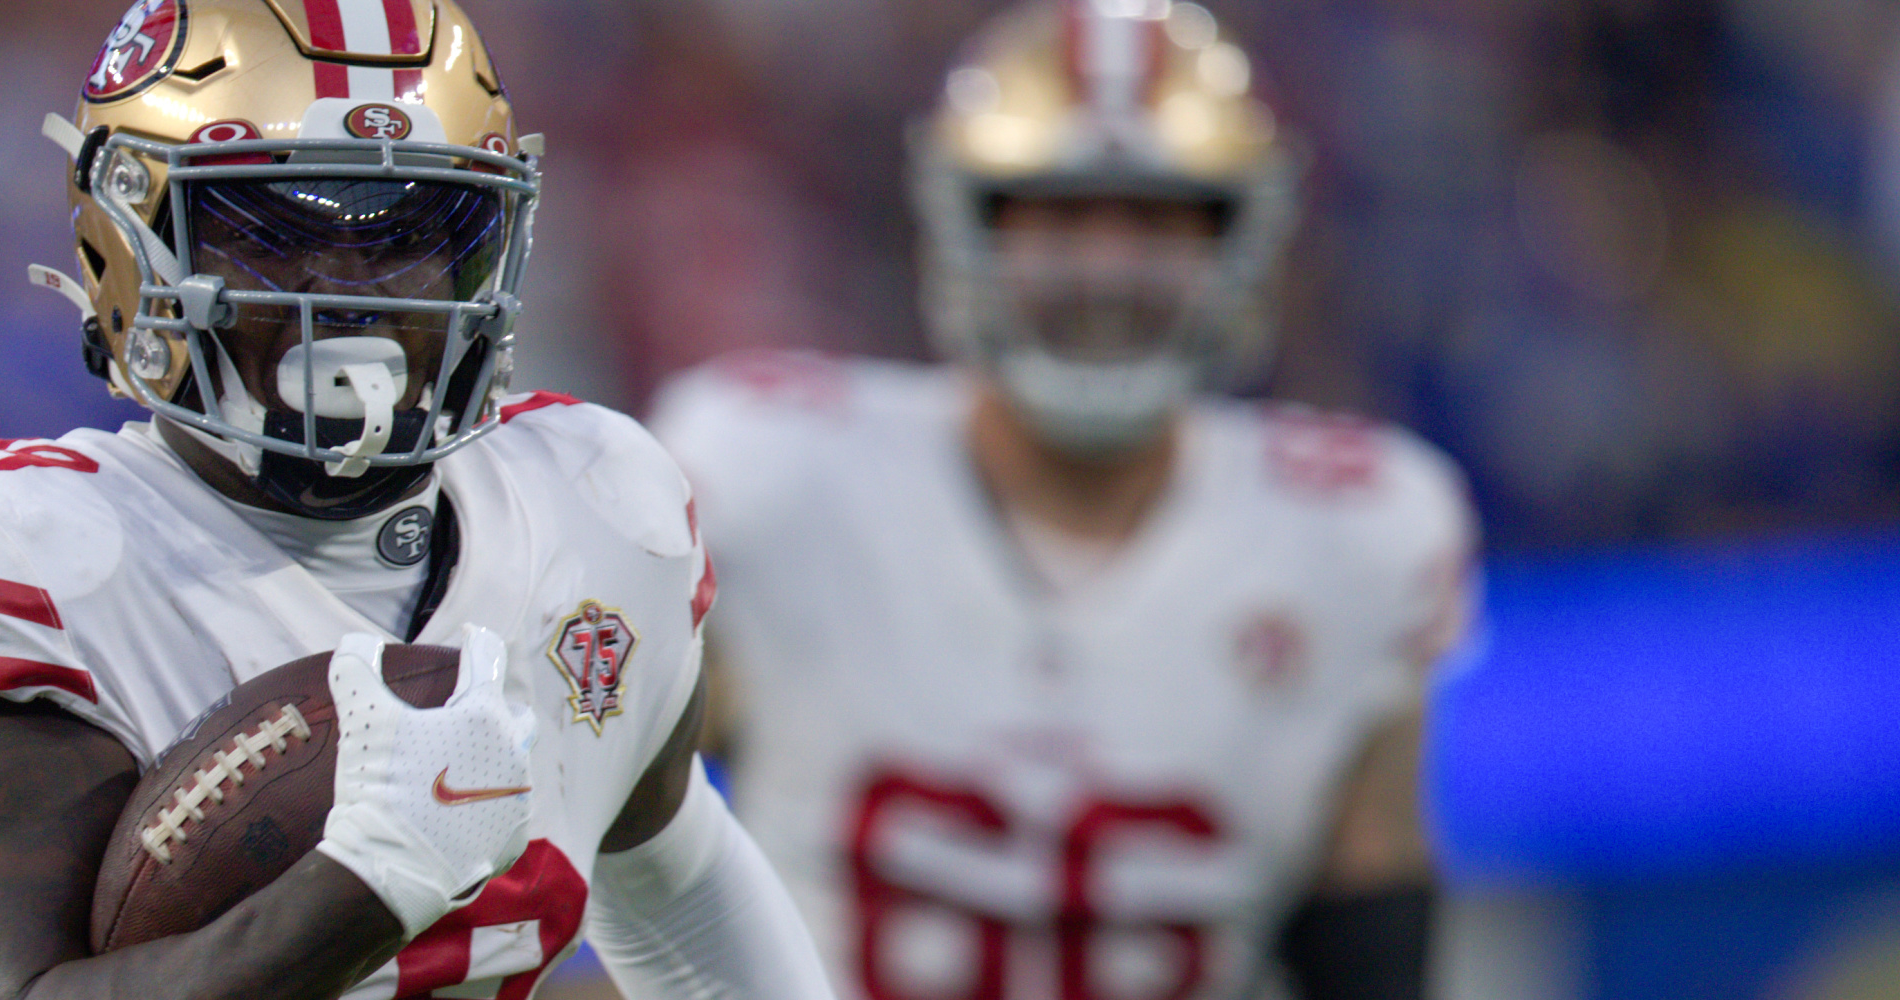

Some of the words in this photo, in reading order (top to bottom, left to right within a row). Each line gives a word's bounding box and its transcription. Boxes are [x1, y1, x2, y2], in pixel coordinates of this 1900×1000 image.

[364, 107, 403, 139] SF
[394, 513, 429, 558] SF
[570, 625, 619, 691] 75
